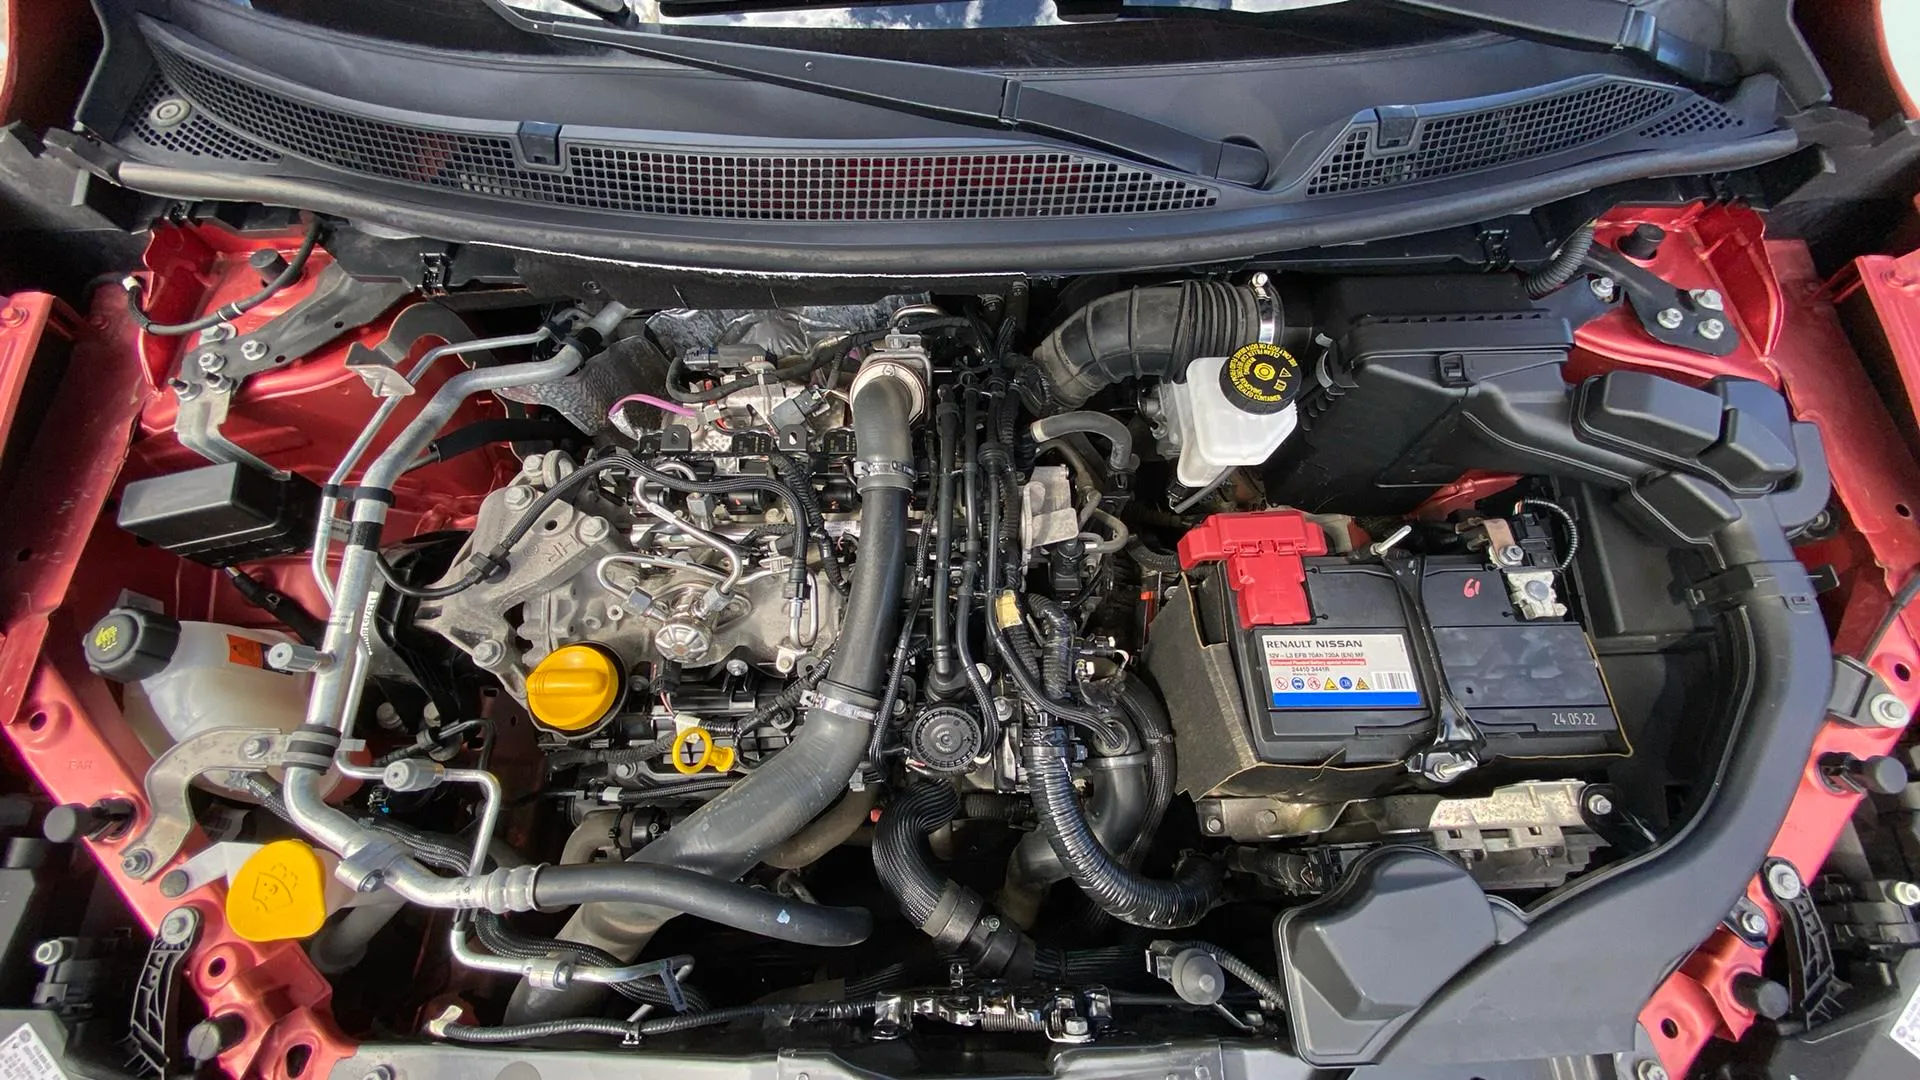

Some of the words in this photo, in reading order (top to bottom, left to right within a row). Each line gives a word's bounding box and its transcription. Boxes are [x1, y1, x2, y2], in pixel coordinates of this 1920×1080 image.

[1236, 384, 1254, 398] SEALED
[1266, 640, 1312, 649] RENAULT
[1316, 640, 1363, 648] NISSAN
